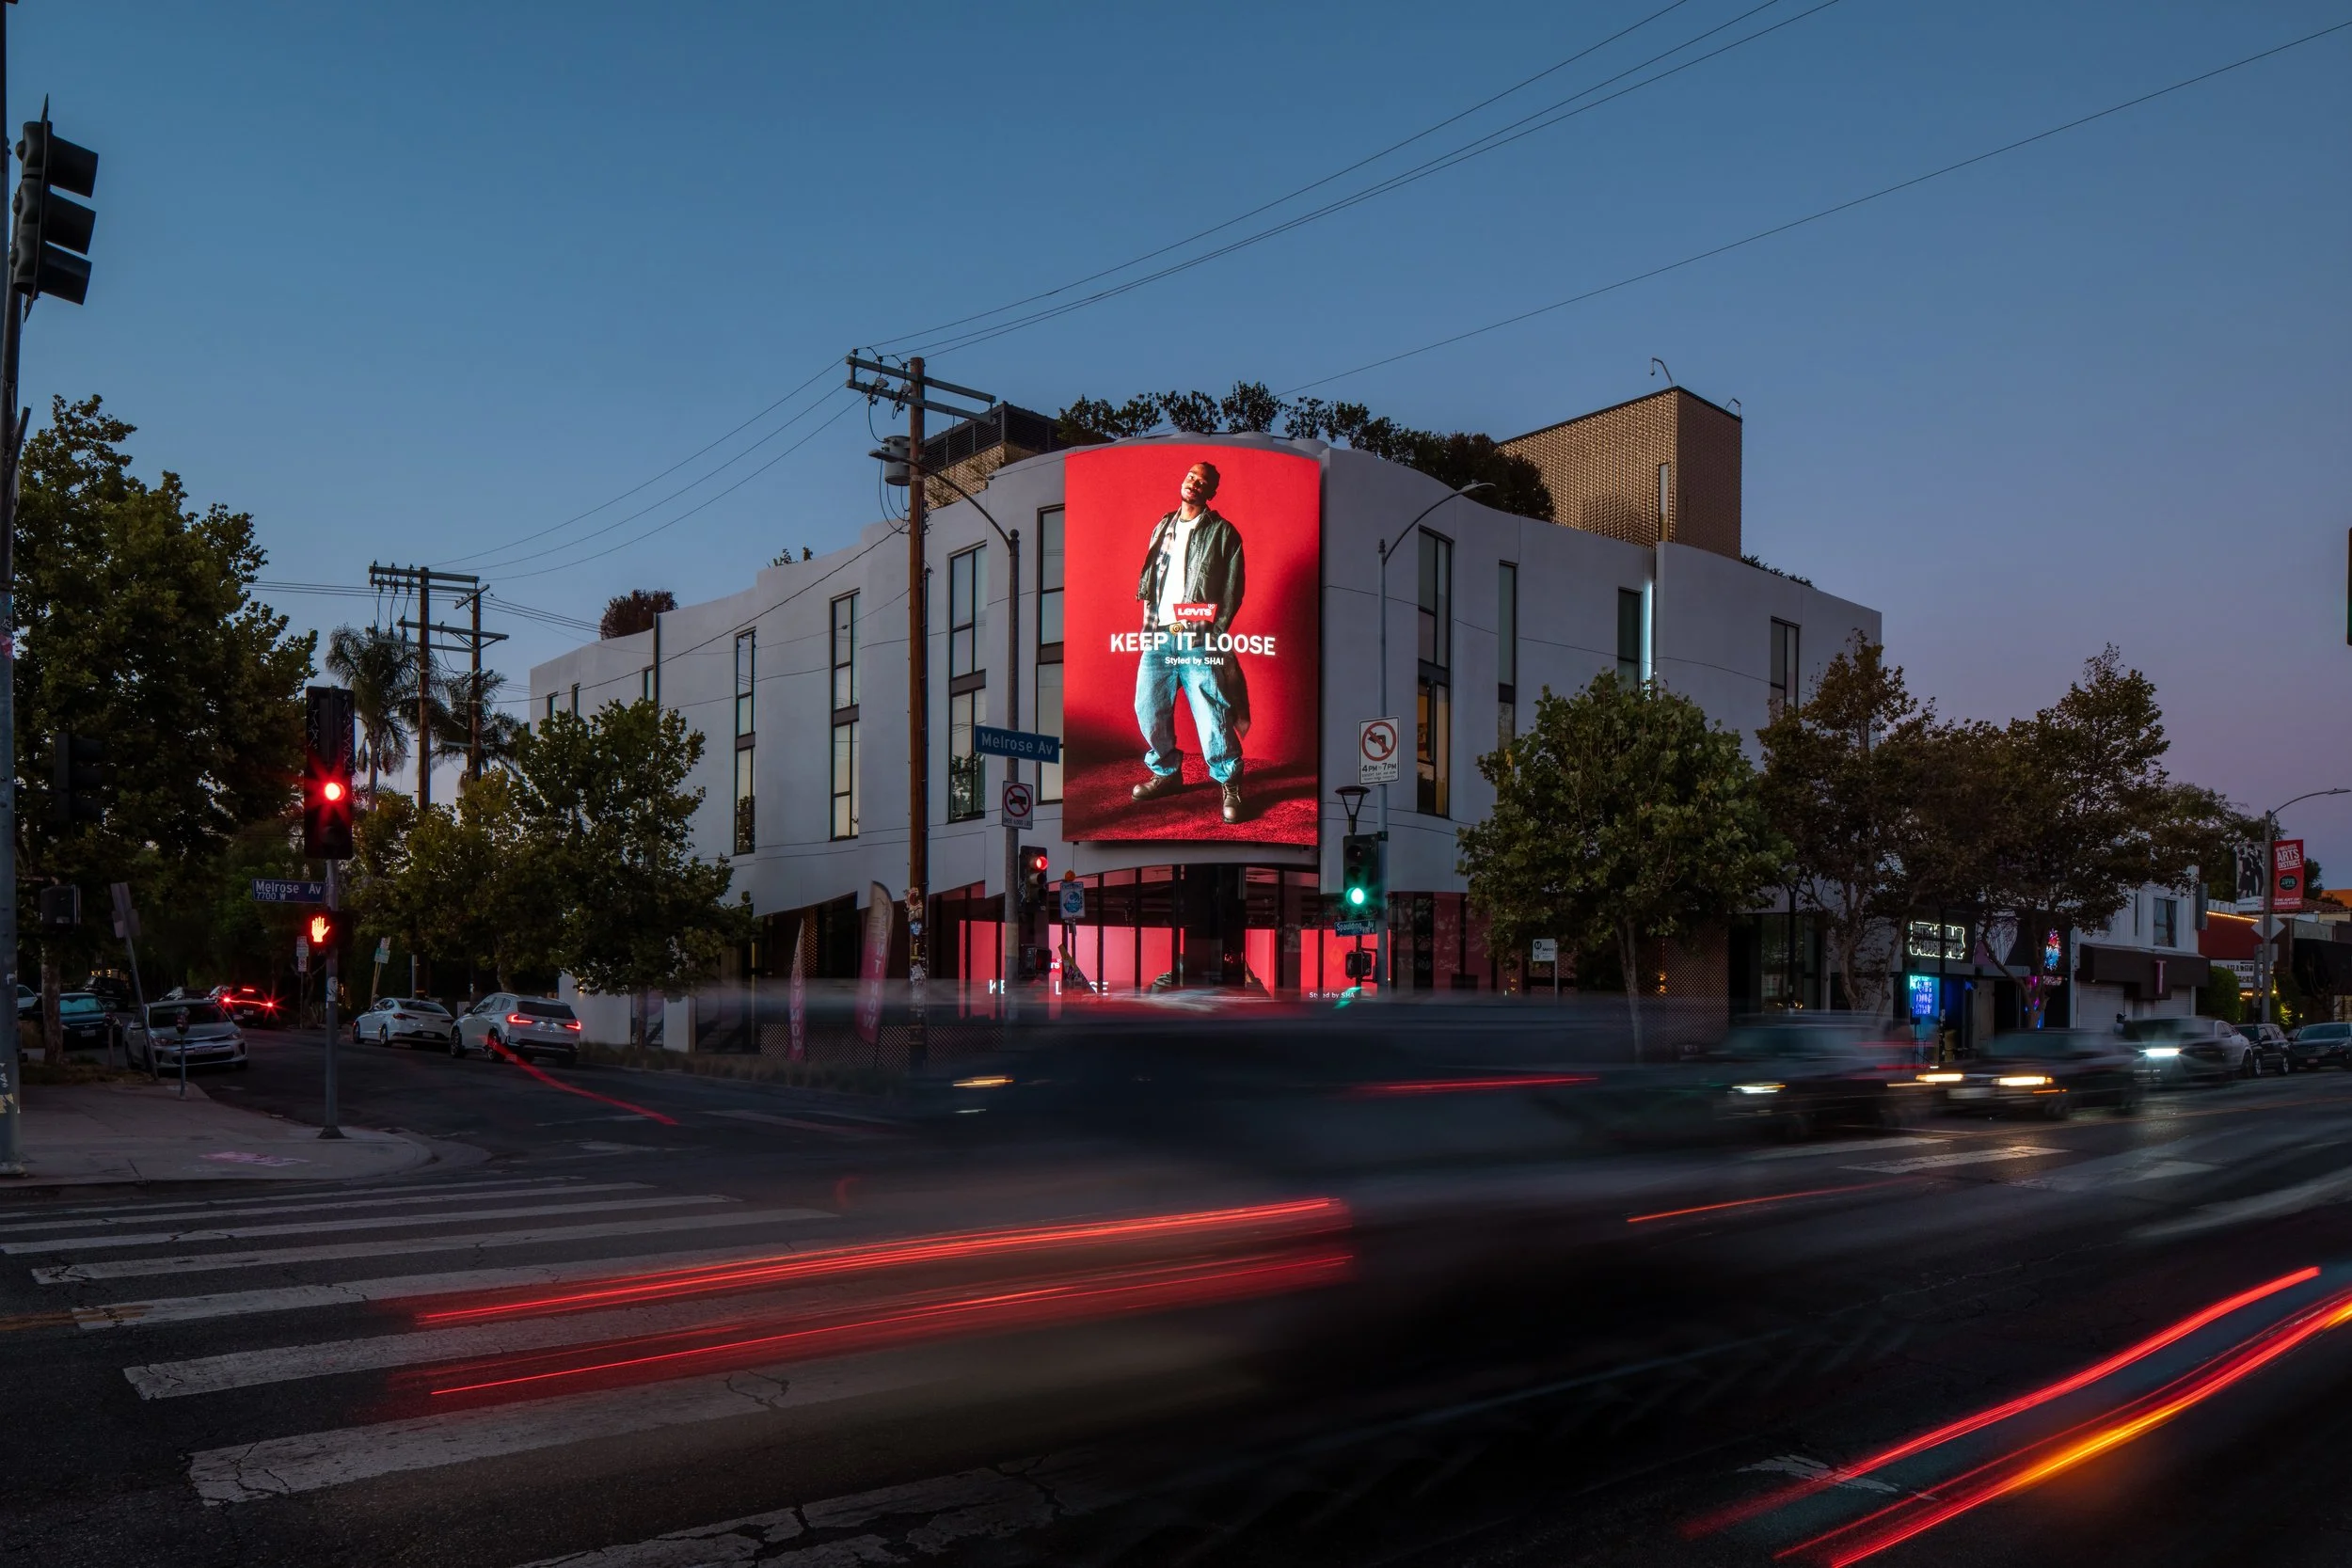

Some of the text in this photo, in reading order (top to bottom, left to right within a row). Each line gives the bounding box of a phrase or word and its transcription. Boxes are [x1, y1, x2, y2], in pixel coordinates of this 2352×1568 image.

[1110, 632, 1276, 656] KEEP IT LOOSE
[1165, 657, 1191, 666] Styled
[1192, 657, 1202, 666] by
[981, 733, 1053, 755] Melrose Av
[2277, 849, 2300, 862] ARTS
[2278, 858, 2301, 869] DISTRICT
[255, 880, 321, 895] Melrose Av
[257, 892, 277, 900] 7700
